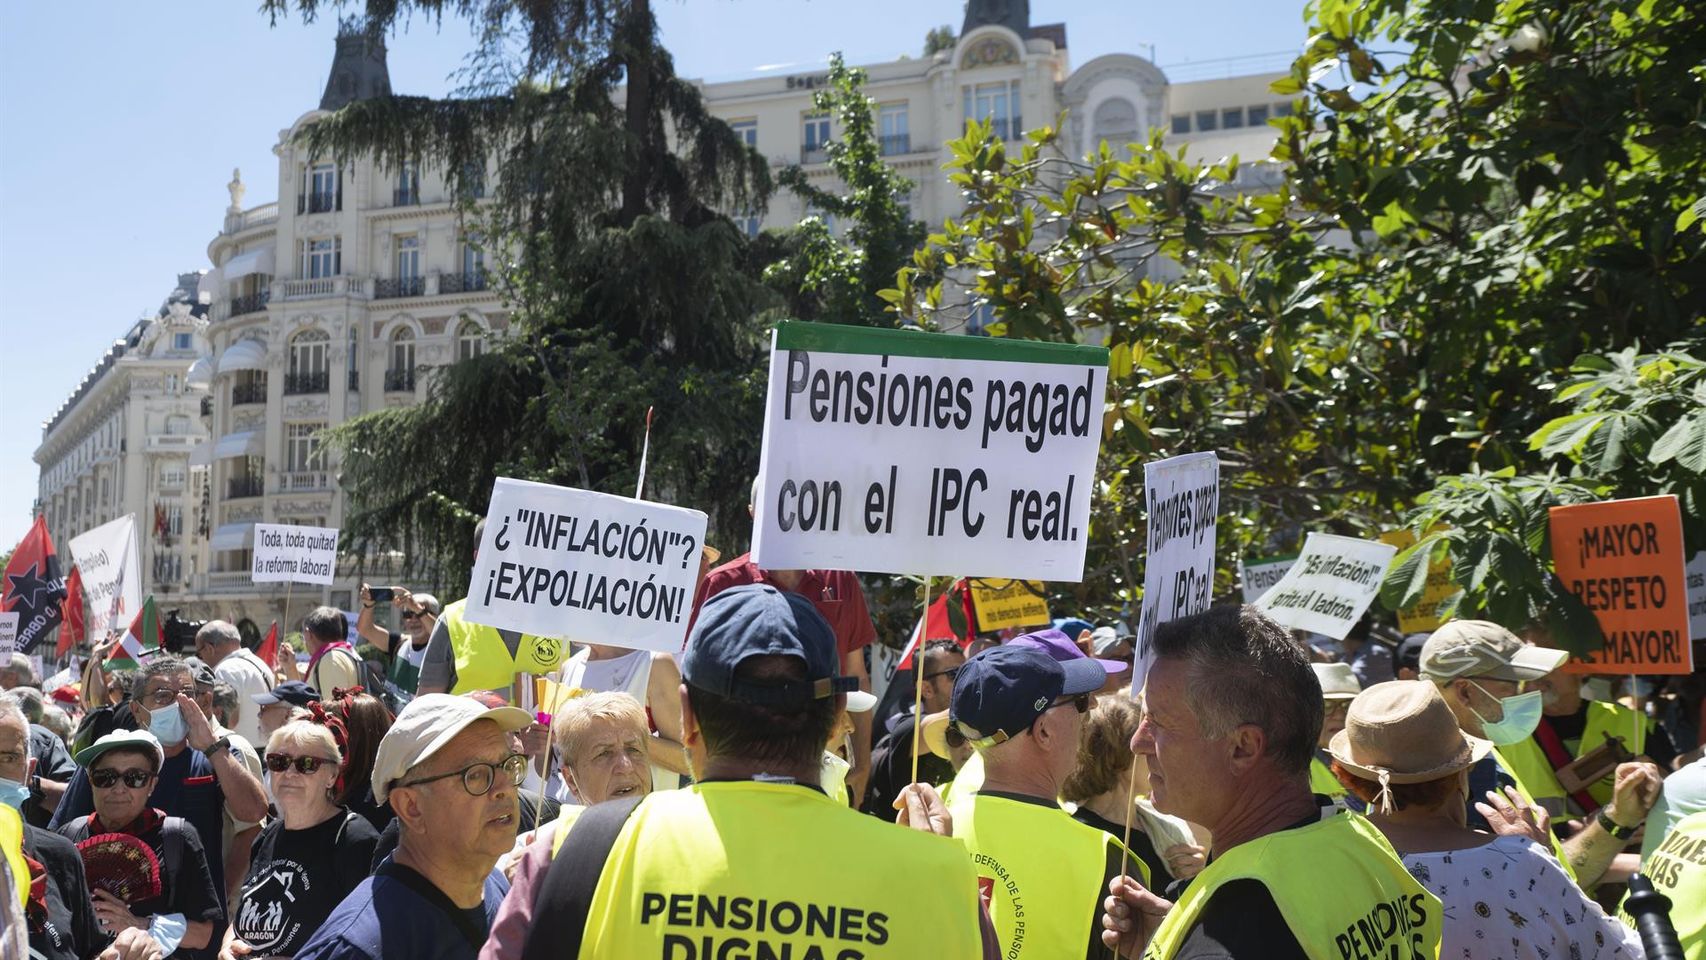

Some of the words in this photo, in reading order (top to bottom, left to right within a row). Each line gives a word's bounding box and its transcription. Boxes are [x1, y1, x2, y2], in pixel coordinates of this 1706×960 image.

[784, 350, 973, 430] Pensiones
[982, 368, 1094, 453] pagad
[777, 479, 842, 532] con
[864, 465, 898, 534] el
[927, 467, 988, 538] IPC
[1007, 475, 1078, 541] real.
[260, 529, 283, 549] Toda,
[285, 531, 305, 548] toda
[307, 533, 336, 553] quitad
[1578, 522, 1660, 569] ¡MAYOR
[255, 556, 263, 573] la
[265, 556, 298, 573] reforma
[300, 557, 331, 576] laboral
[484, 562, 685, 624] ¡EXPOLIACIÓN!
[1602, 630, 1682, 664] MAYOR!
[974, 853, 1010, 882] DEFENSA
[1006, 880, 1020, 896] DE
[641, 892, 889, 946] PENSIONES
[1012, 897, 1025, 918] LAS
[271, 922, 301, 956] Pensiones
